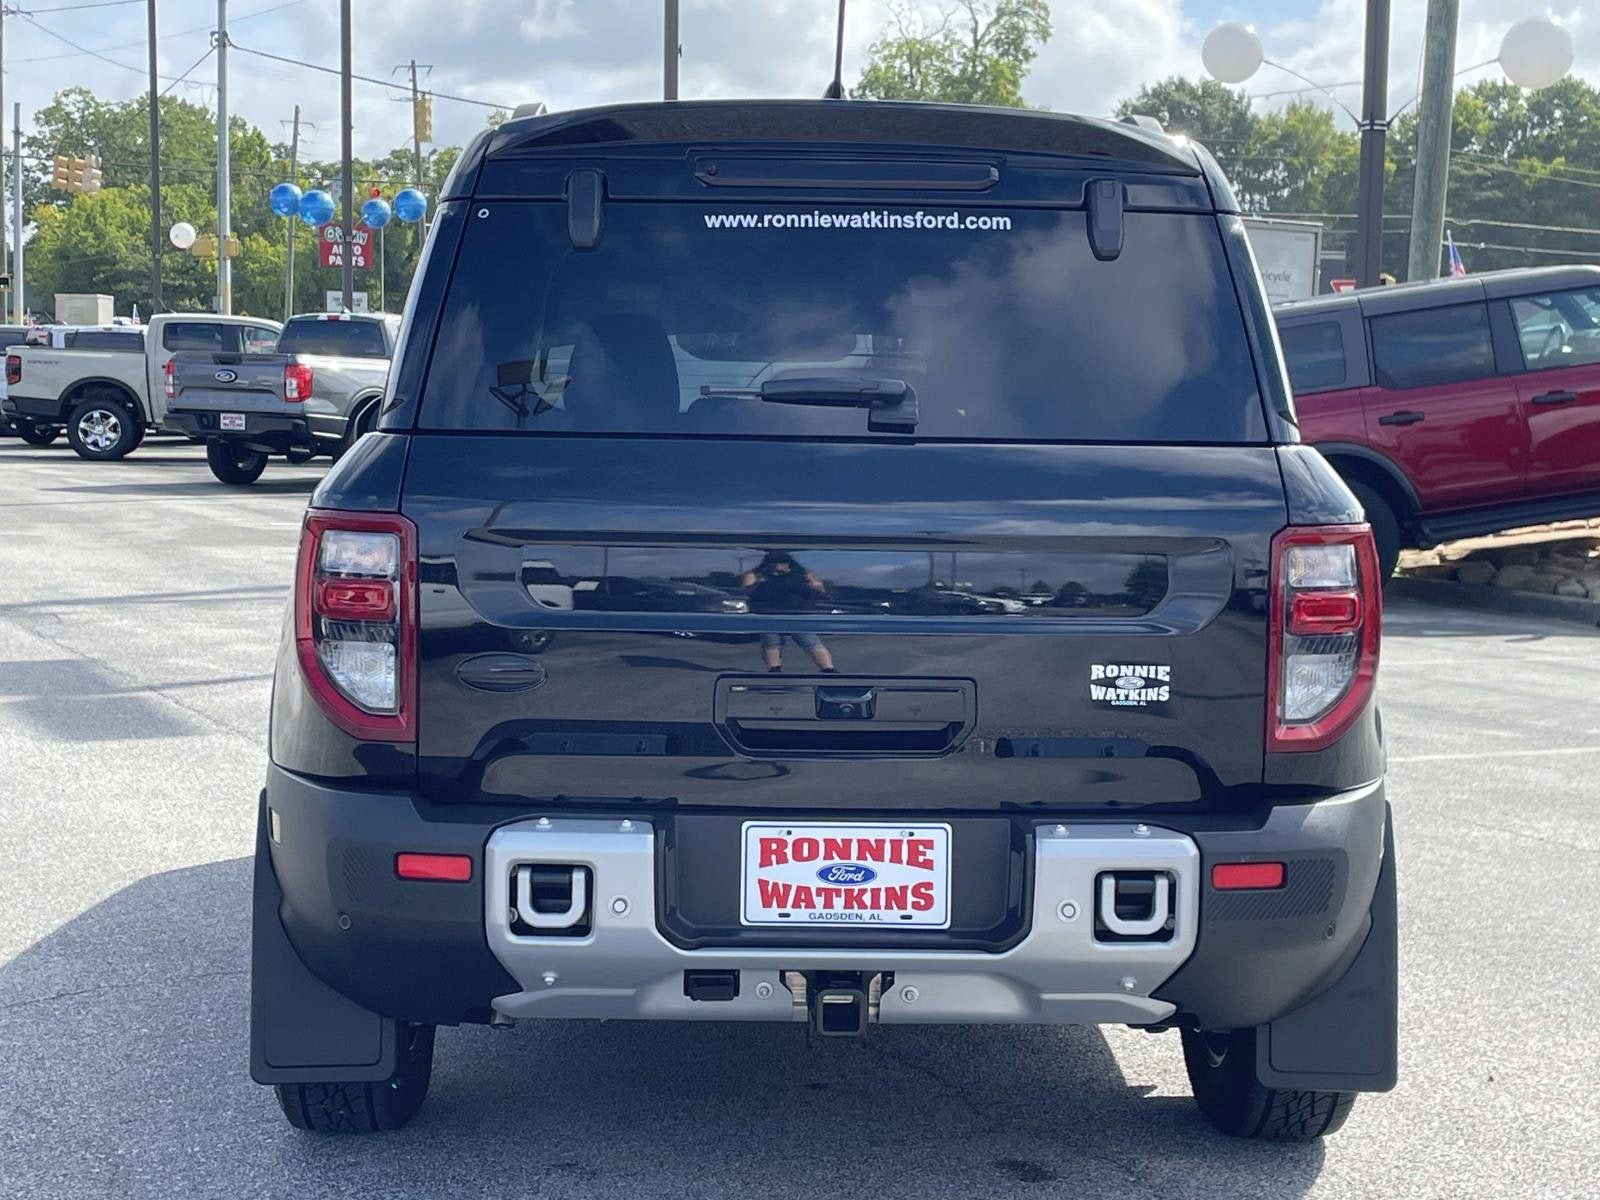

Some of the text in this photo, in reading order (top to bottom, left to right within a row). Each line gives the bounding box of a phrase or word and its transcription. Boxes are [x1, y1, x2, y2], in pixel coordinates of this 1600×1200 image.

[703, 211, 1012, 230] www.ronniewatkinsford.com
[331, 244, 362, 255] AO
[328, 255, 365, 266] PATS
[1090, 664, 1171, 681] RONNIE
[1090, 684, 1170, 701] WATKINS
[758, 837, 935, 871] RONNIE
[828, 866, 866, 881] Ford
[757, 878, 935, 911] WATKINS
[808, 912, 883, 921] GADSDEN, AL
